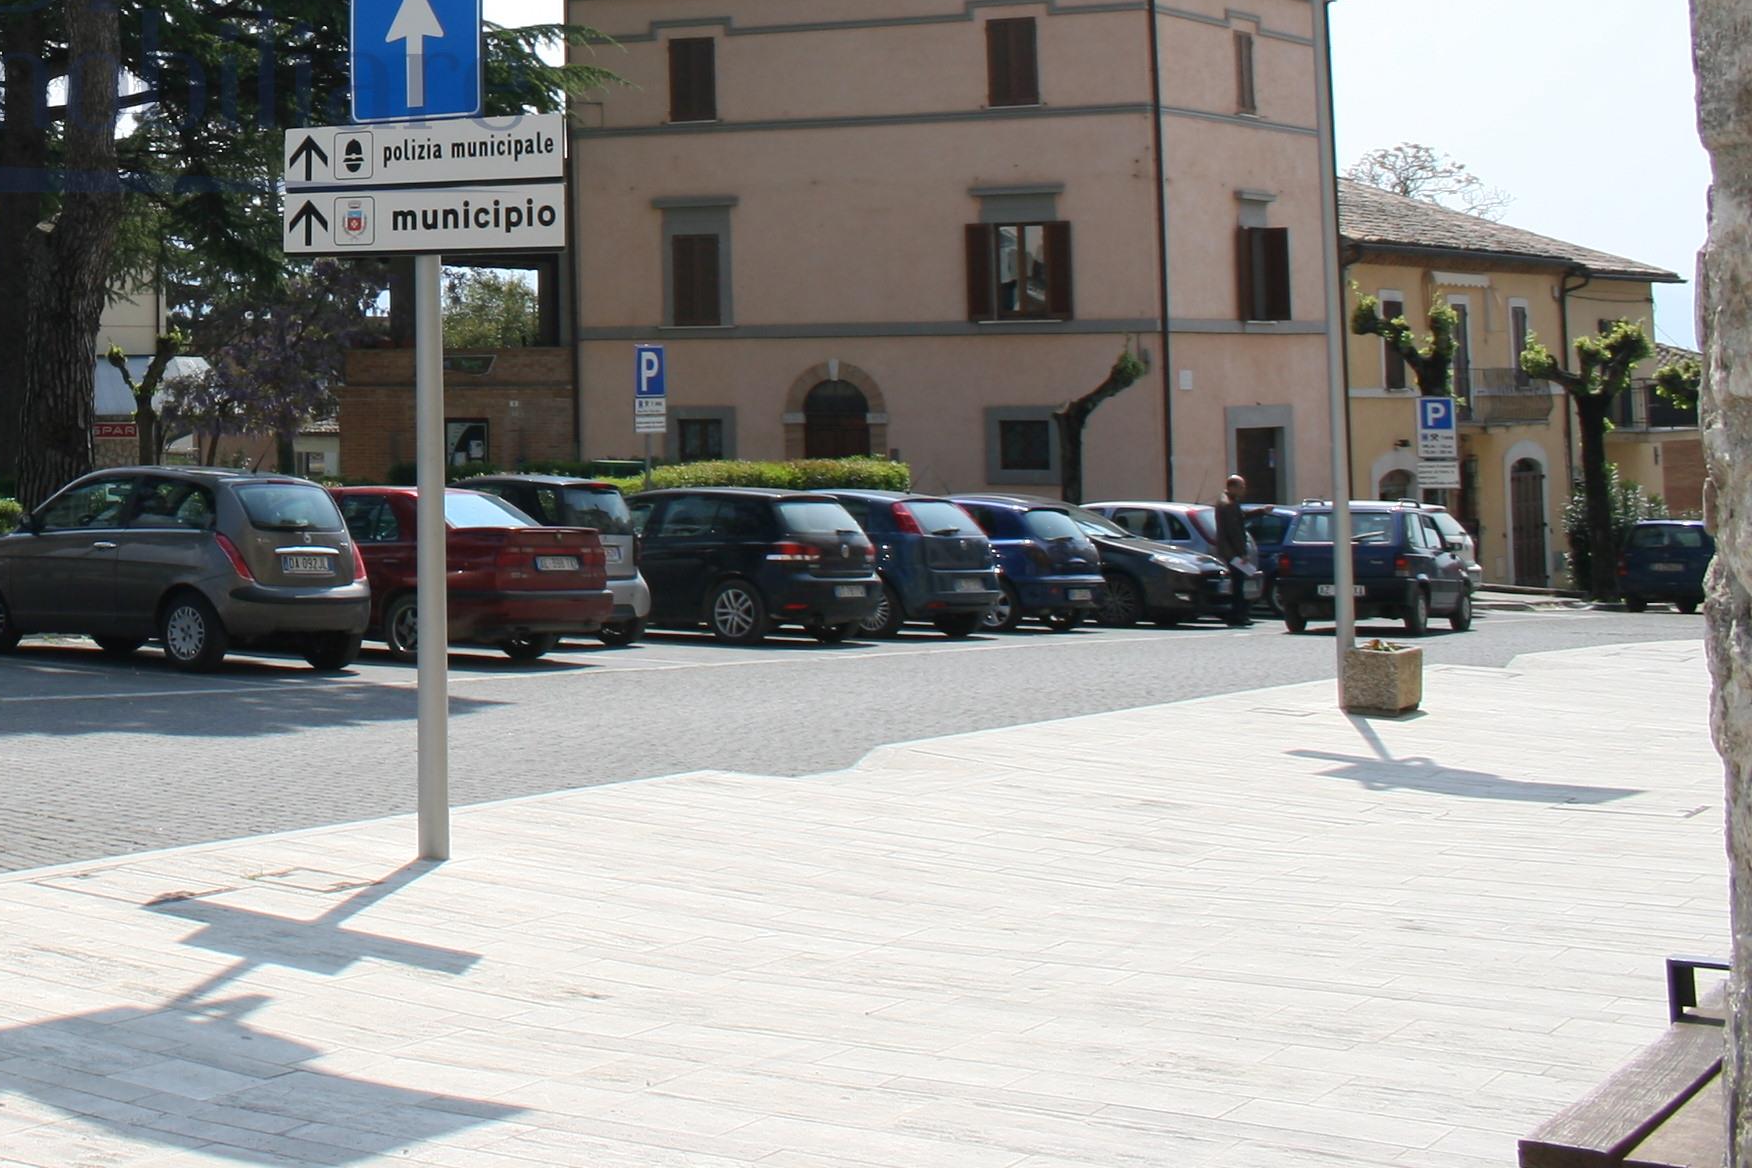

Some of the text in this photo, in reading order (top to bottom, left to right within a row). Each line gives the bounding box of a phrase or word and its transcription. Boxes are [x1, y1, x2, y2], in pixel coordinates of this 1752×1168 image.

[383, 131, 555, 168] polizia municipale
[392, 198, 557, 233] municipio
[641, 351, 659, 392] P
[1426, 402, 1446, 427] P
